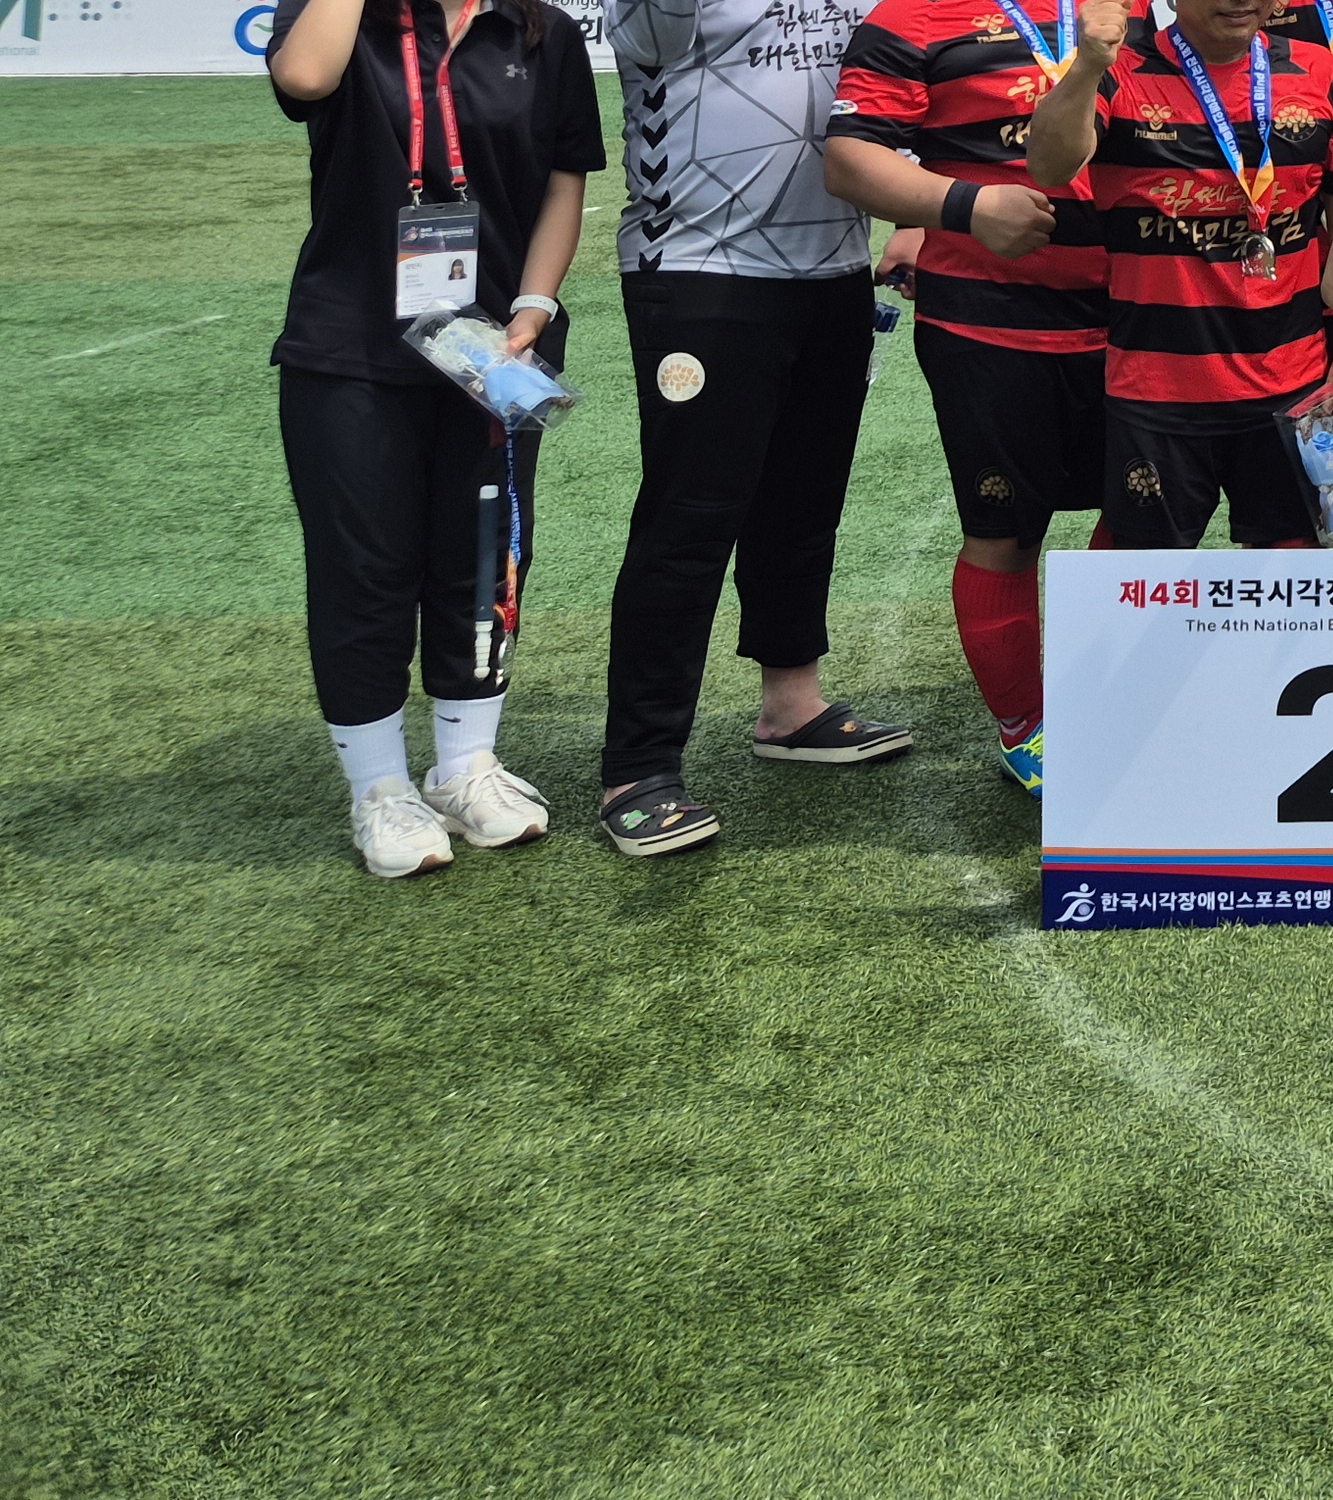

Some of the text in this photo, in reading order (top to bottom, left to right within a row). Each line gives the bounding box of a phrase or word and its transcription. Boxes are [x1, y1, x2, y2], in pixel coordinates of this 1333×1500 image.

[1251, 70, 1266, 102] Blind
[1134, 127, 1178, 141] hummel
[1119, 577, 1201, 611] 제4회
[1186, 618, 1217, 633] The
[1221, 618, 1249, 633] 4th
[1254, 617, 1324, 633] National
[1100, 888, 1332, 914] 한국시각장애인스포츠연맹
